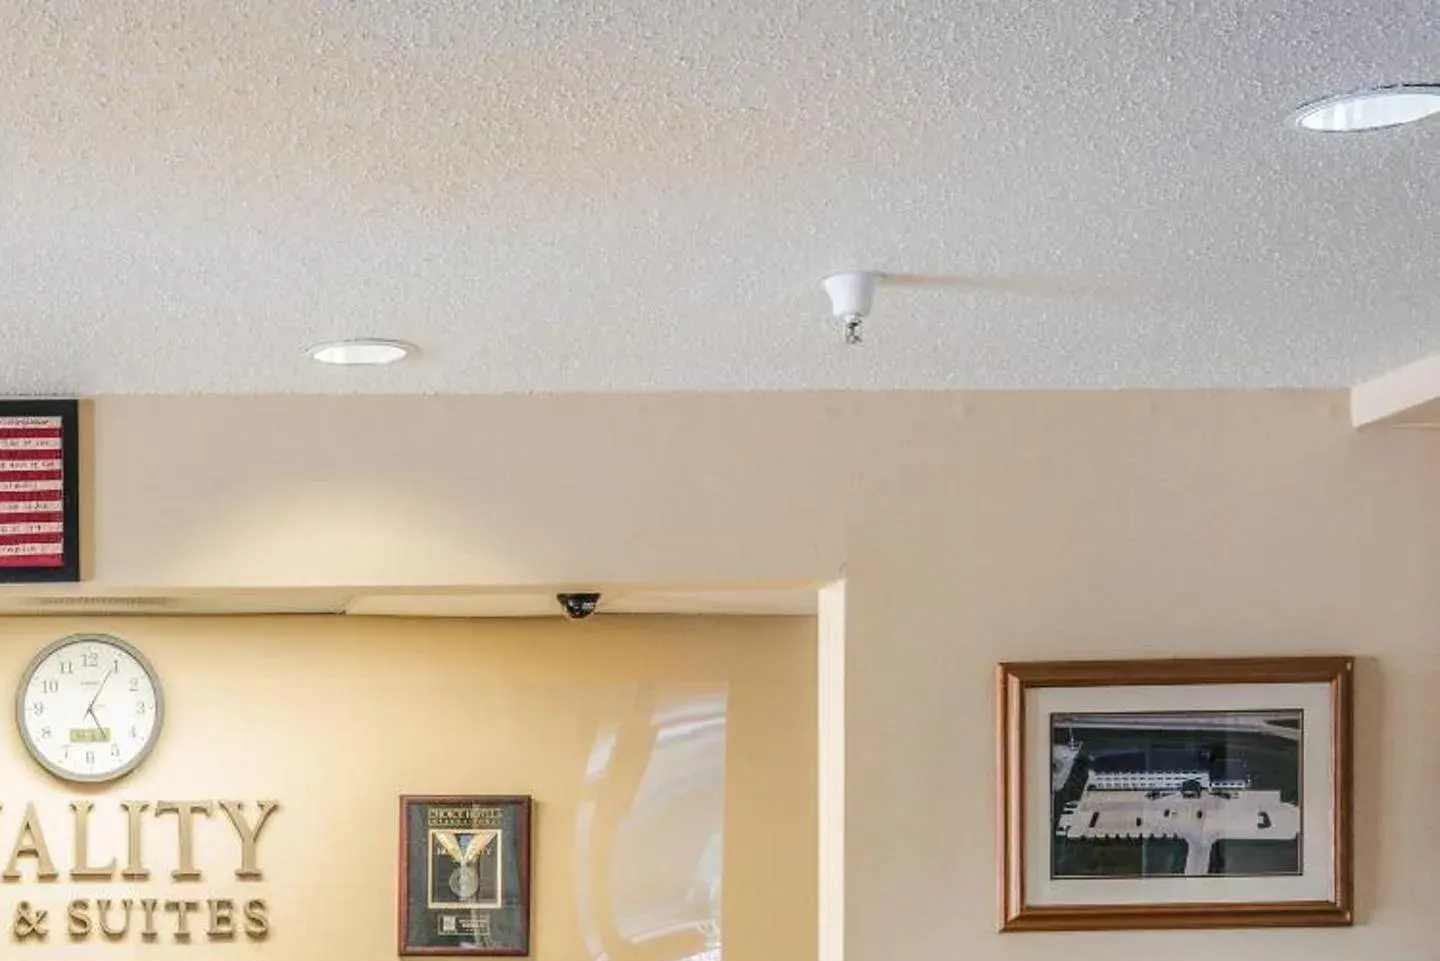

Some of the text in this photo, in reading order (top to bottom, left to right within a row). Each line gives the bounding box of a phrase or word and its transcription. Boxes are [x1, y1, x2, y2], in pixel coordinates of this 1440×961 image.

[81, 653, 98, 667] 12
[60, 661, 74, 674] 11
[42, 679, 58, 693] 10
[129, 677, 138, 692] 2
[33, 702, 44, 715] 9
[136, 702, 145, 714] 3
[41, 726, 51, 739] 8
[13, 899, 49, 938] &
[67, 898, 269, 942] SUITES
